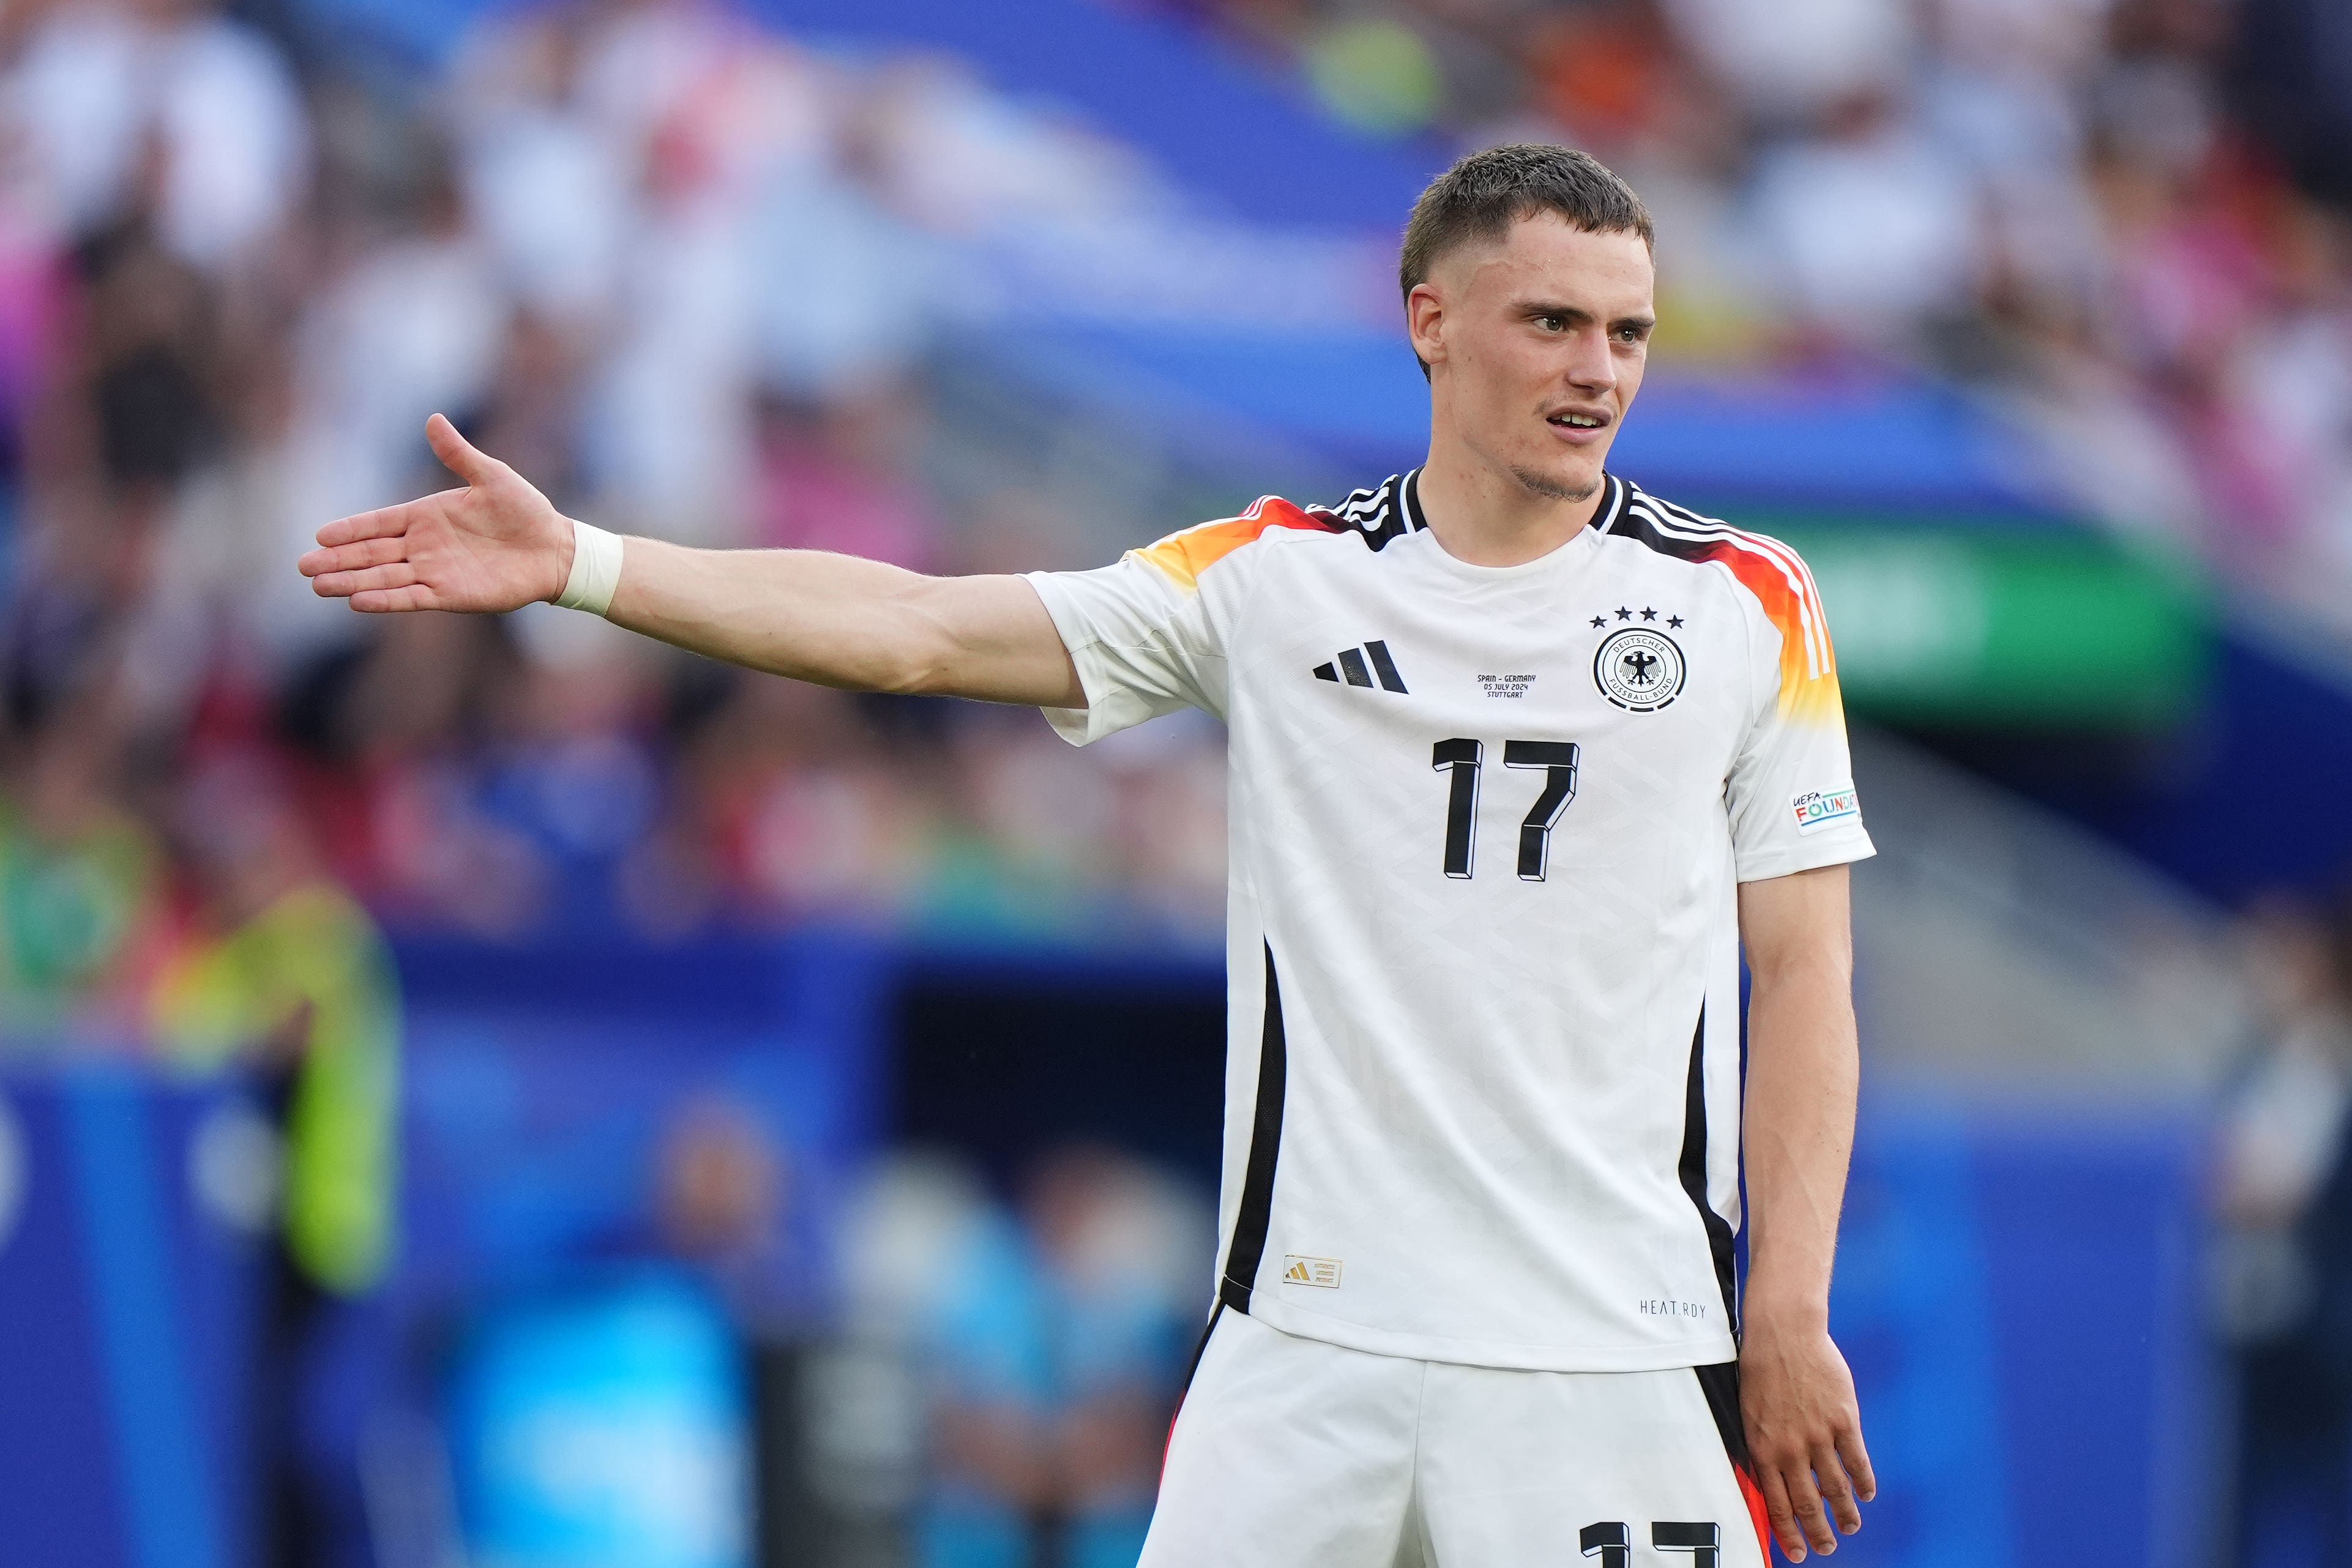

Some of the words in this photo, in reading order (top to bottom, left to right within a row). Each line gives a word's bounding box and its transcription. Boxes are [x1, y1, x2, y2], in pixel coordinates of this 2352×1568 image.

[1613, 637, 1665, 653] DEUTSCHER
[1609, 678, 1672, 701] FUSSBALL-BUND
[1432, 738, 1580, 882] 17
[1793, 792, 1821, 807] UEFA
[1640, 1299, 1706, 1320] HEAT.RDY
